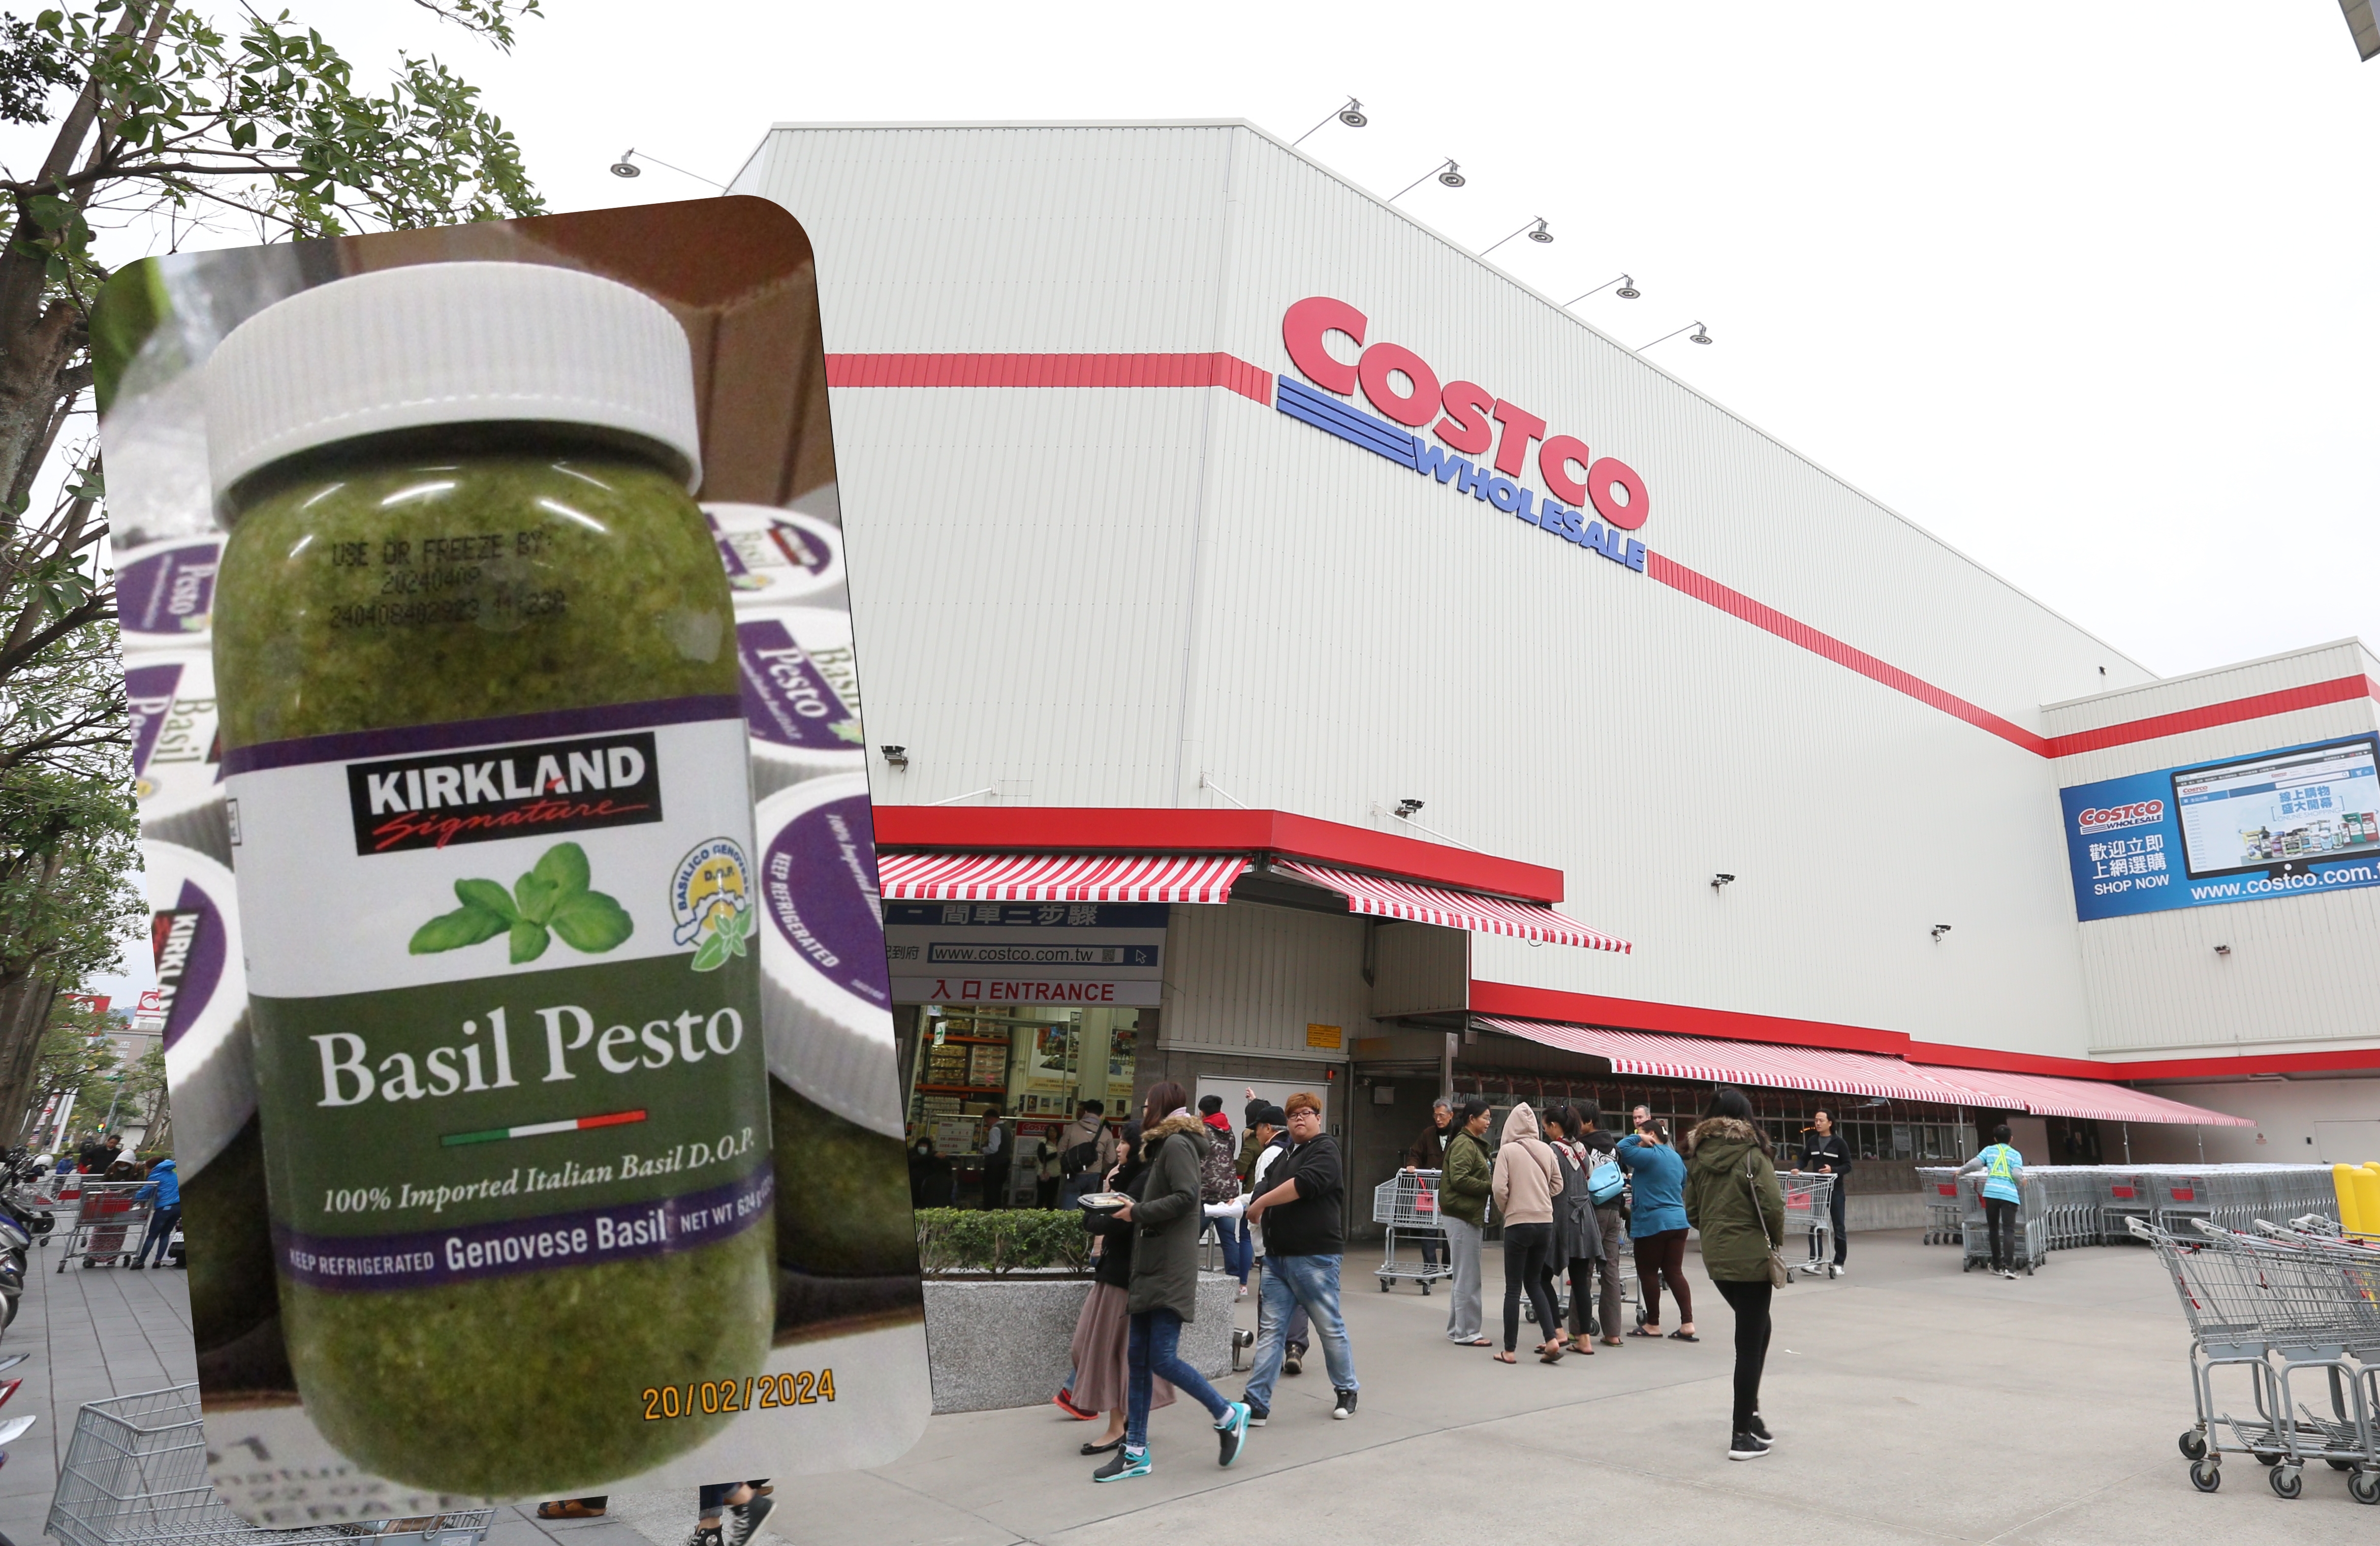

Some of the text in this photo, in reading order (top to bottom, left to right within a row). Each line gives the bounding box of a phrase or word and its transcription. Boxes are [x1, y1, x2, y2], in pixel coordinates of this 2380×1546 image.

[1283, 296, 1649, 530] COSTCO
[1412, 435, 1646, 573] WHOLESALE
[333, 541, 369, 567] USE
[383, 540, 411, 566] OR
[423, 534, 504, 563] FREEZE
[756, 646, 828, 718] Pesto
[151, 697, 216, 765] Basil
[367, 746, 645, 815] KIRKLAND
[2279, 786, 2331, 803] 線上購物
[2079, 800, 2163, 826] COSTCO
[2107, 814, 2162, 829] WHOLESALE
[2276, 807, 2342, 822] ONLINE SHOPPING
[2281, 797, 2333, 815] 盛大開幕
[372, 799, 648, 850] Signature
[2089, 834, 2164, 861] 歡迎立即
[677, 849, 710, 911] BASILICO
[2092, 852, 2167, 880] 上網選購
[2094, 874, 2170, 896] SHOP NOW
[770, 852, 839, 968] KEEP REFRIGERATED
[934, 947, 1093, 962] www.costco.com.tw
[931, 979, 1115, 1001] 入口 ENTRANCE
[309, 1005, 743, 1106] Basil Pesto
[324, 1127, 755, 1213] 100% Imported Italian Basil D.O.P.
[681, 1210, 708, 1233] NET
[712, 1202, 733, 1226] WT
[446, 1209, 667, 1270] Genovese Basil
[290, 1248, 434, 1276] KEEP REFRIGERATED
